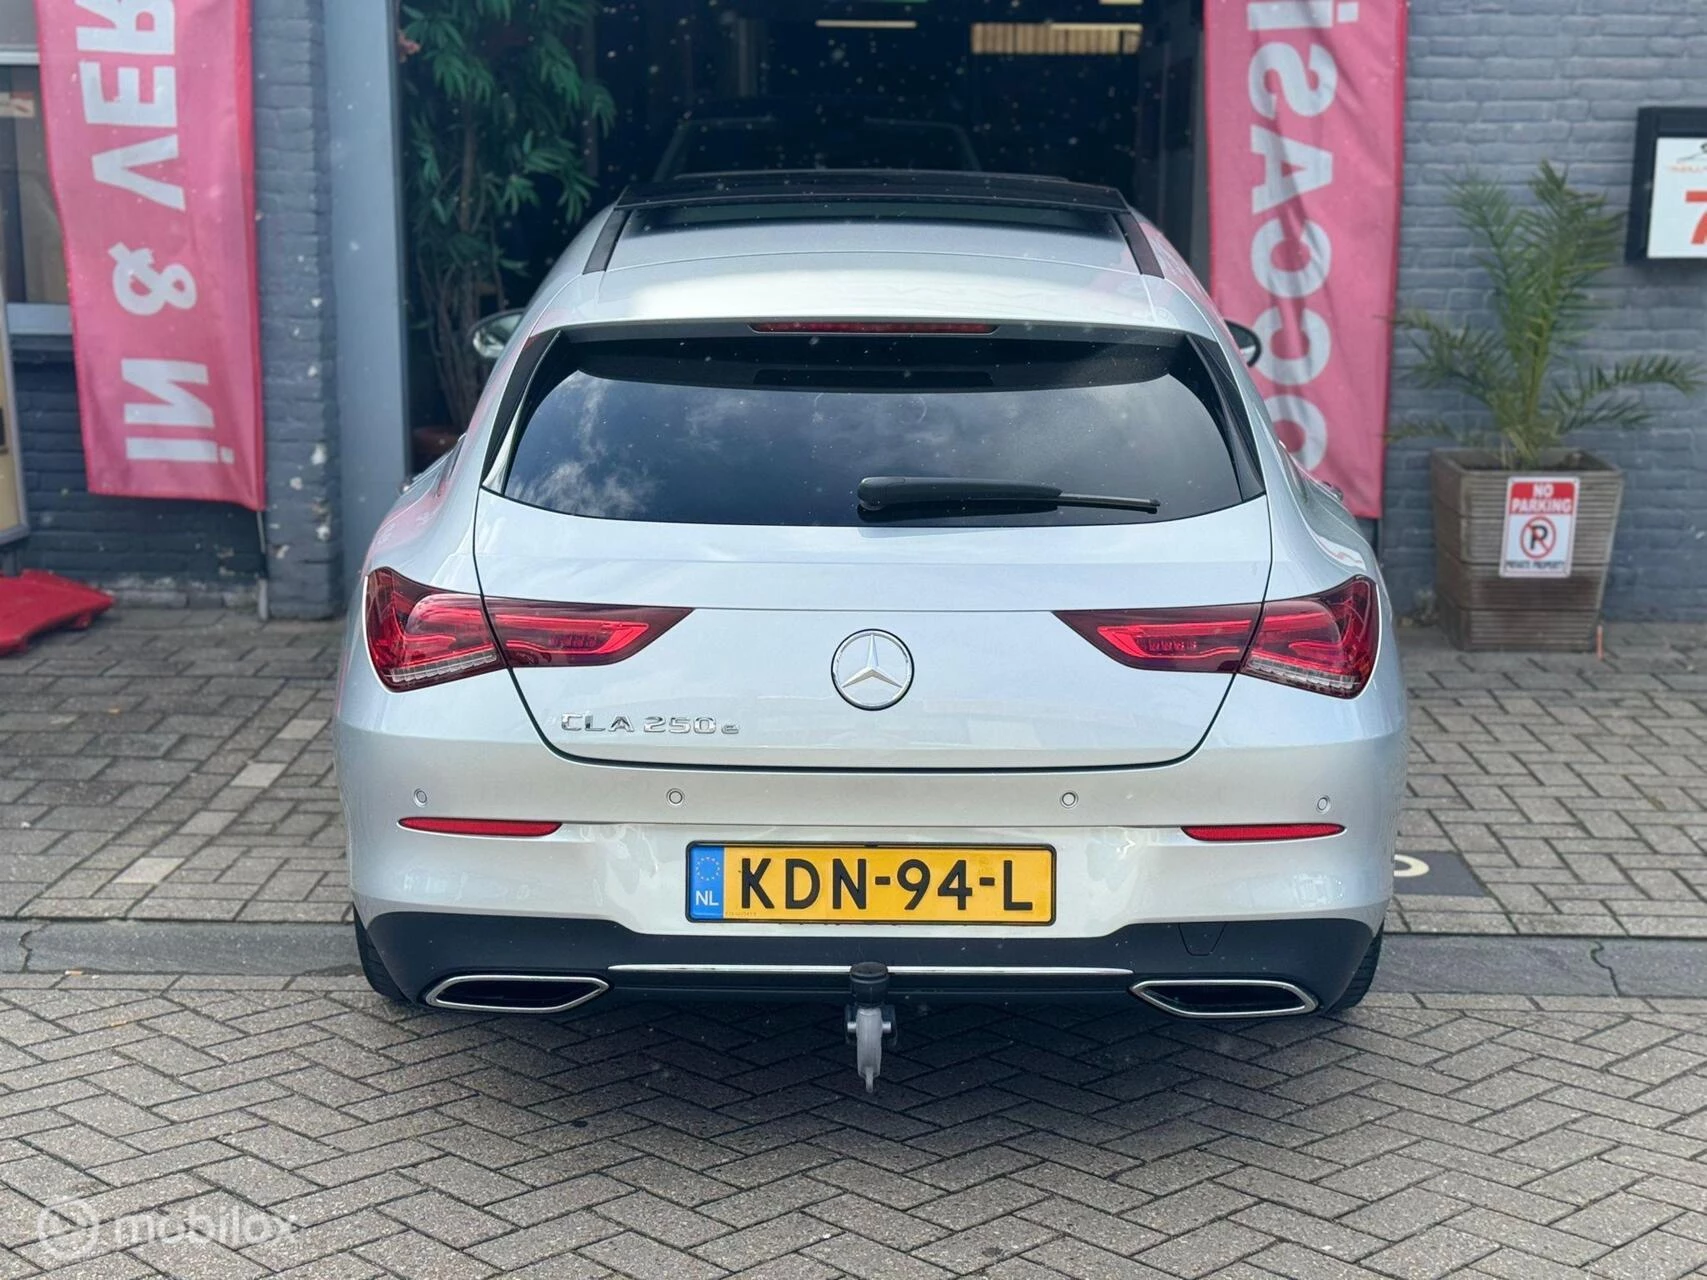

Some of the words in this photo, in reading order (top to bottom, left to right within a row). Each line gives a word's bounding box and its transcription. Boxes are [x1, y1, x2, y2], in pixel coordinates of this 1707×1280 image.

[1533, 483, 1555, 498] NO
[1511, 498, 1573, 513] PARKING
[561, 712, 635, 732] CLA
[741, 857, 1033, 911] KDN-94-L
[695, 890, 719, 906] NL
